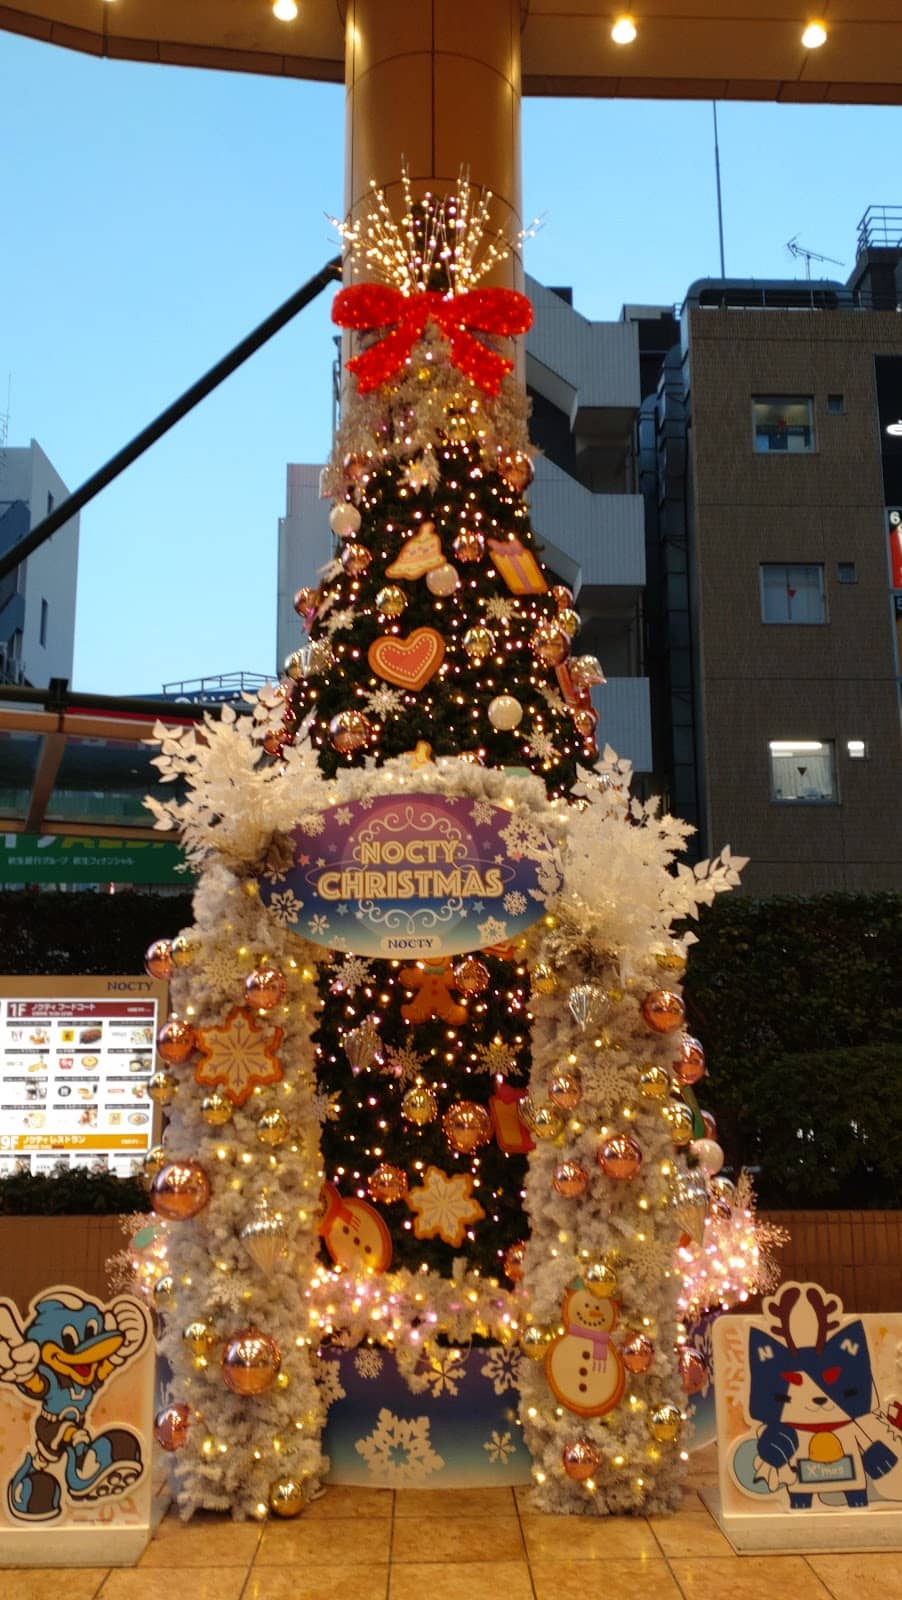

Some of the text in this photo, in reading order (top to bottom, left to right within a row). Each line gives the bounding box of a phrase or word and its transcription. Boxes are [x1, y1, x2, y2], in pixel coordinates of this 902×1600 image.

[360, 839, 459, 865] NOCTY
[317, 868, 505, 900] CHRISTMAS
[387, 938, 435, 949] NOCTY
[107, 981, 154, 991] NOCTY
[10, 1003, 27, 1016] 1F
[0, 1136, 19, 1150] 9F
[50, 1136, 86, 1144] レストラン
